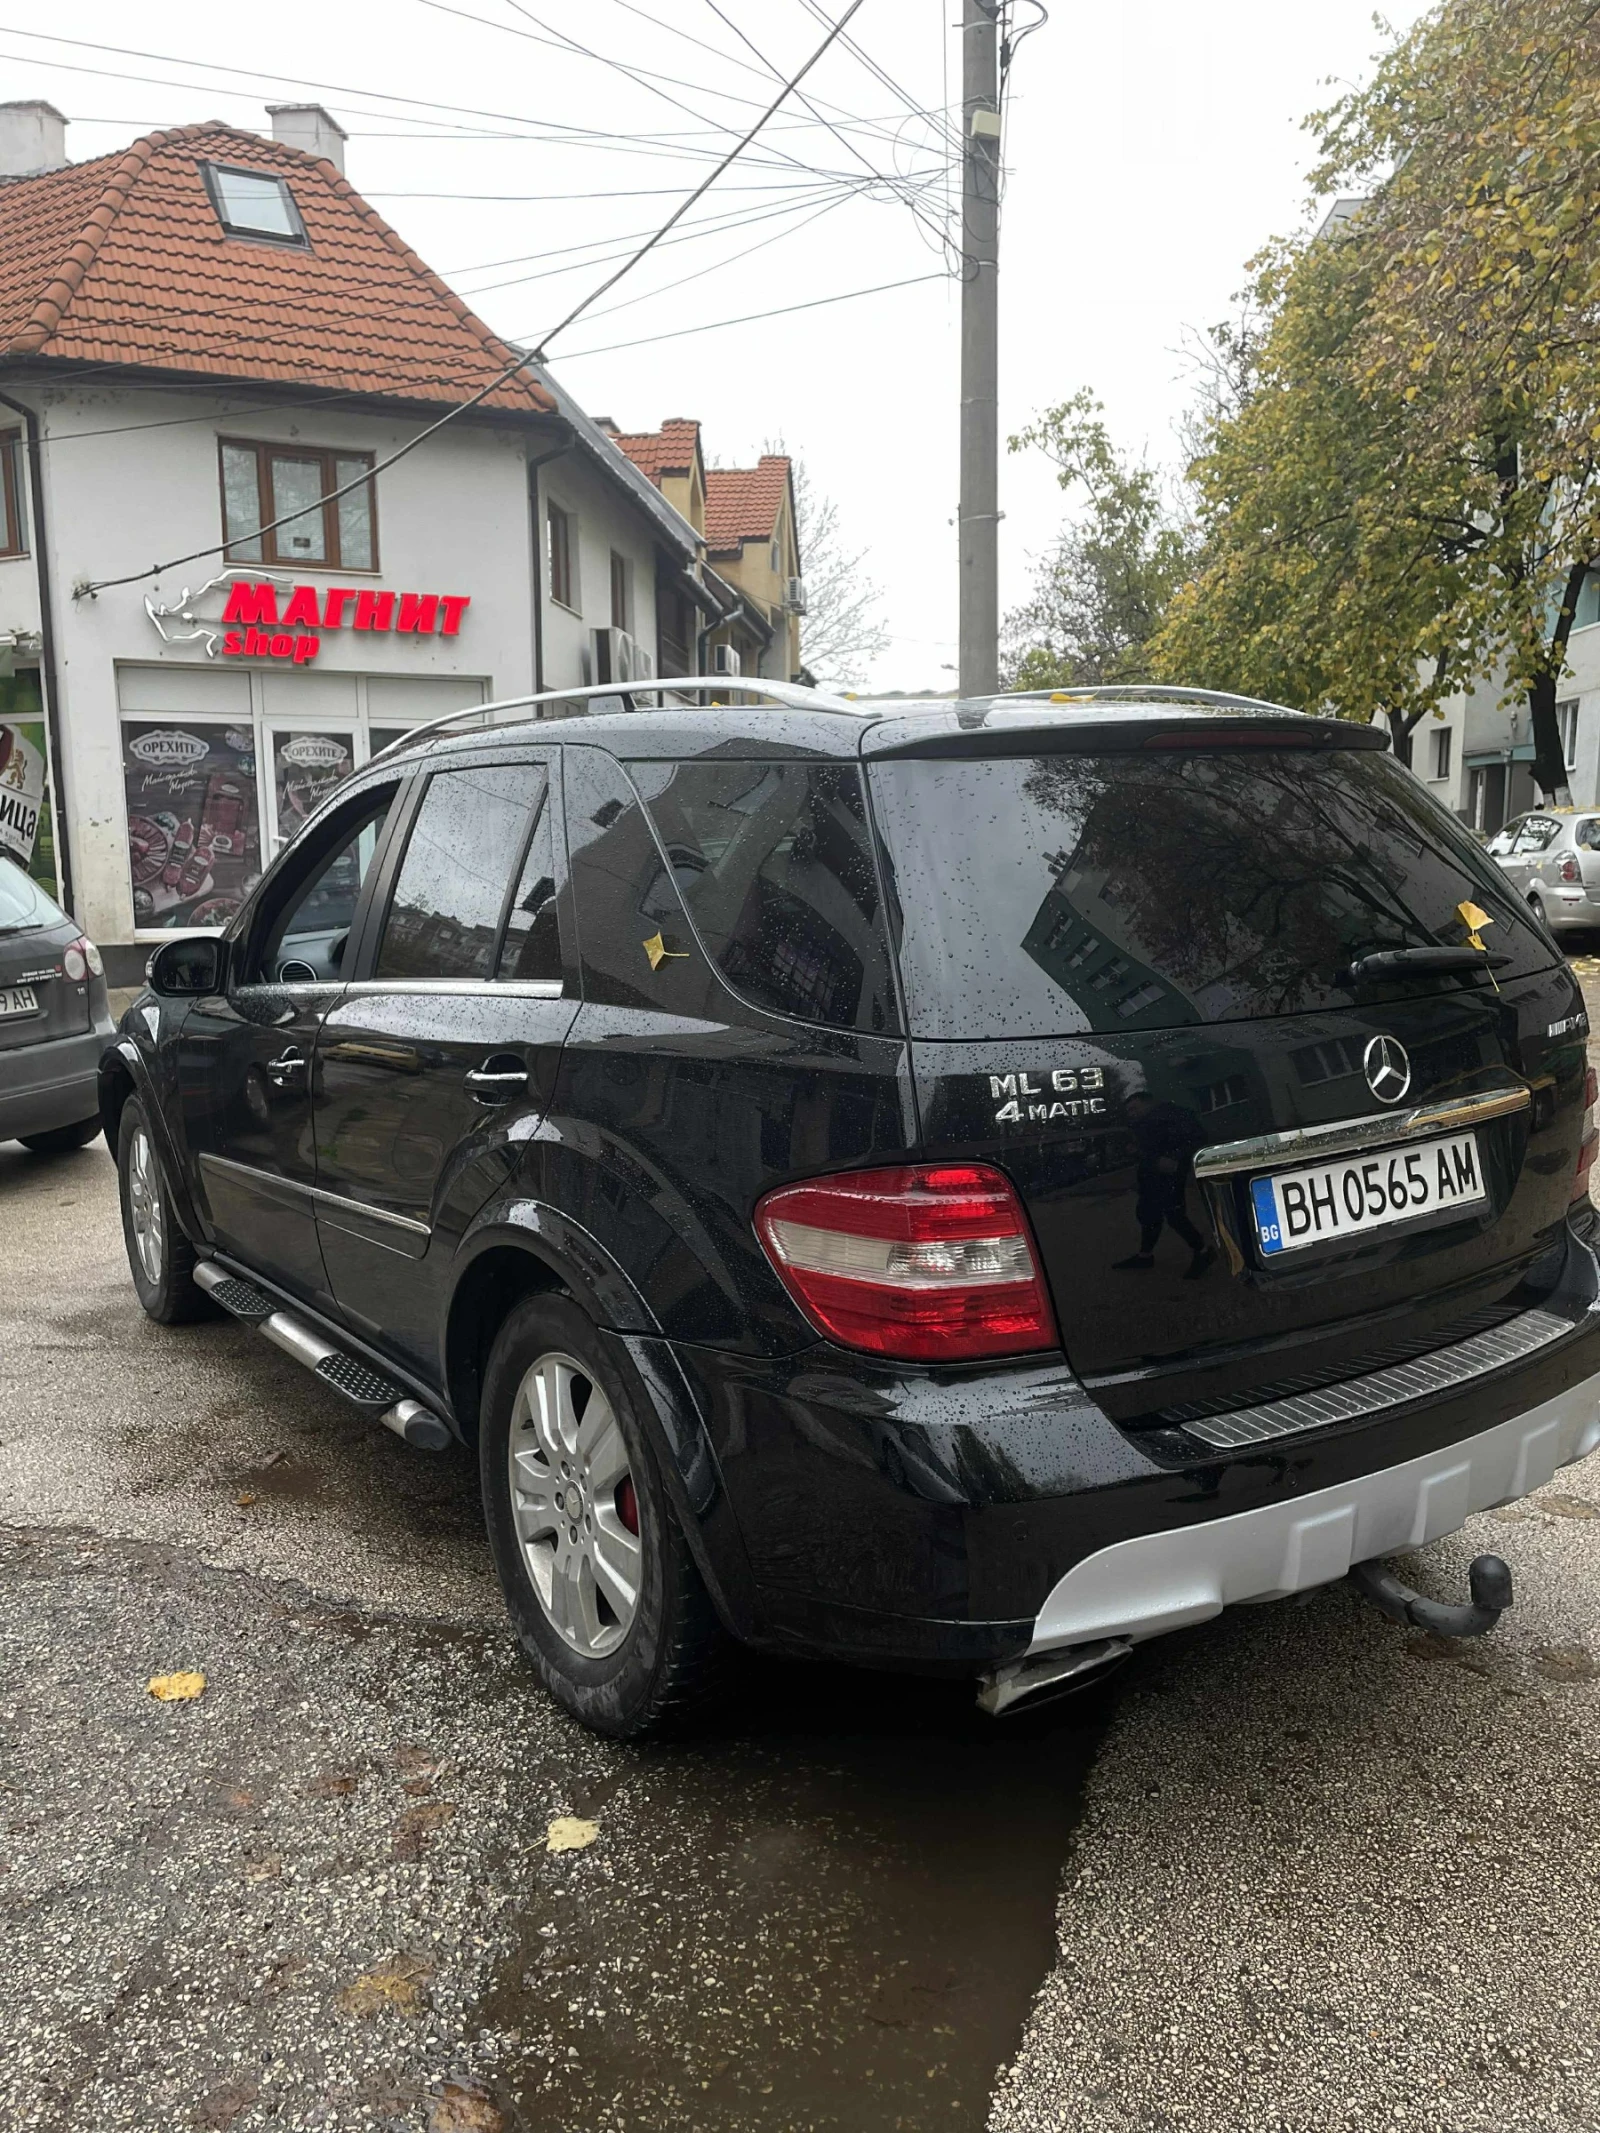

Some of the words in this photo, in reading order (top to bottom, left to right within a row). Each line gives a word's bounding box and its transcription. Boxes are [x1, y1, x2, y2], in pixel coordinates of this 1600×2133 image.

[222, 581, 471, 635] МАГНИТ
[222, 627, 320, 664] shop
[142, 740, 199, 755] ОРЕХИТЕ
[291, 745, 338, 758] ОРЕХИТЕ
[12, 989, 34, 1010] AH
[989, 1073, 1042, 1098] ML
[1051, 1067, 1105, 1092] 63
[1281, 1174, 1339, 1237] BH
[1342, 1153, 1429, 1221] 0565
[1436, 1141, 1478, 1200] AM
[1261, 1225, 1279, 1243] BG
